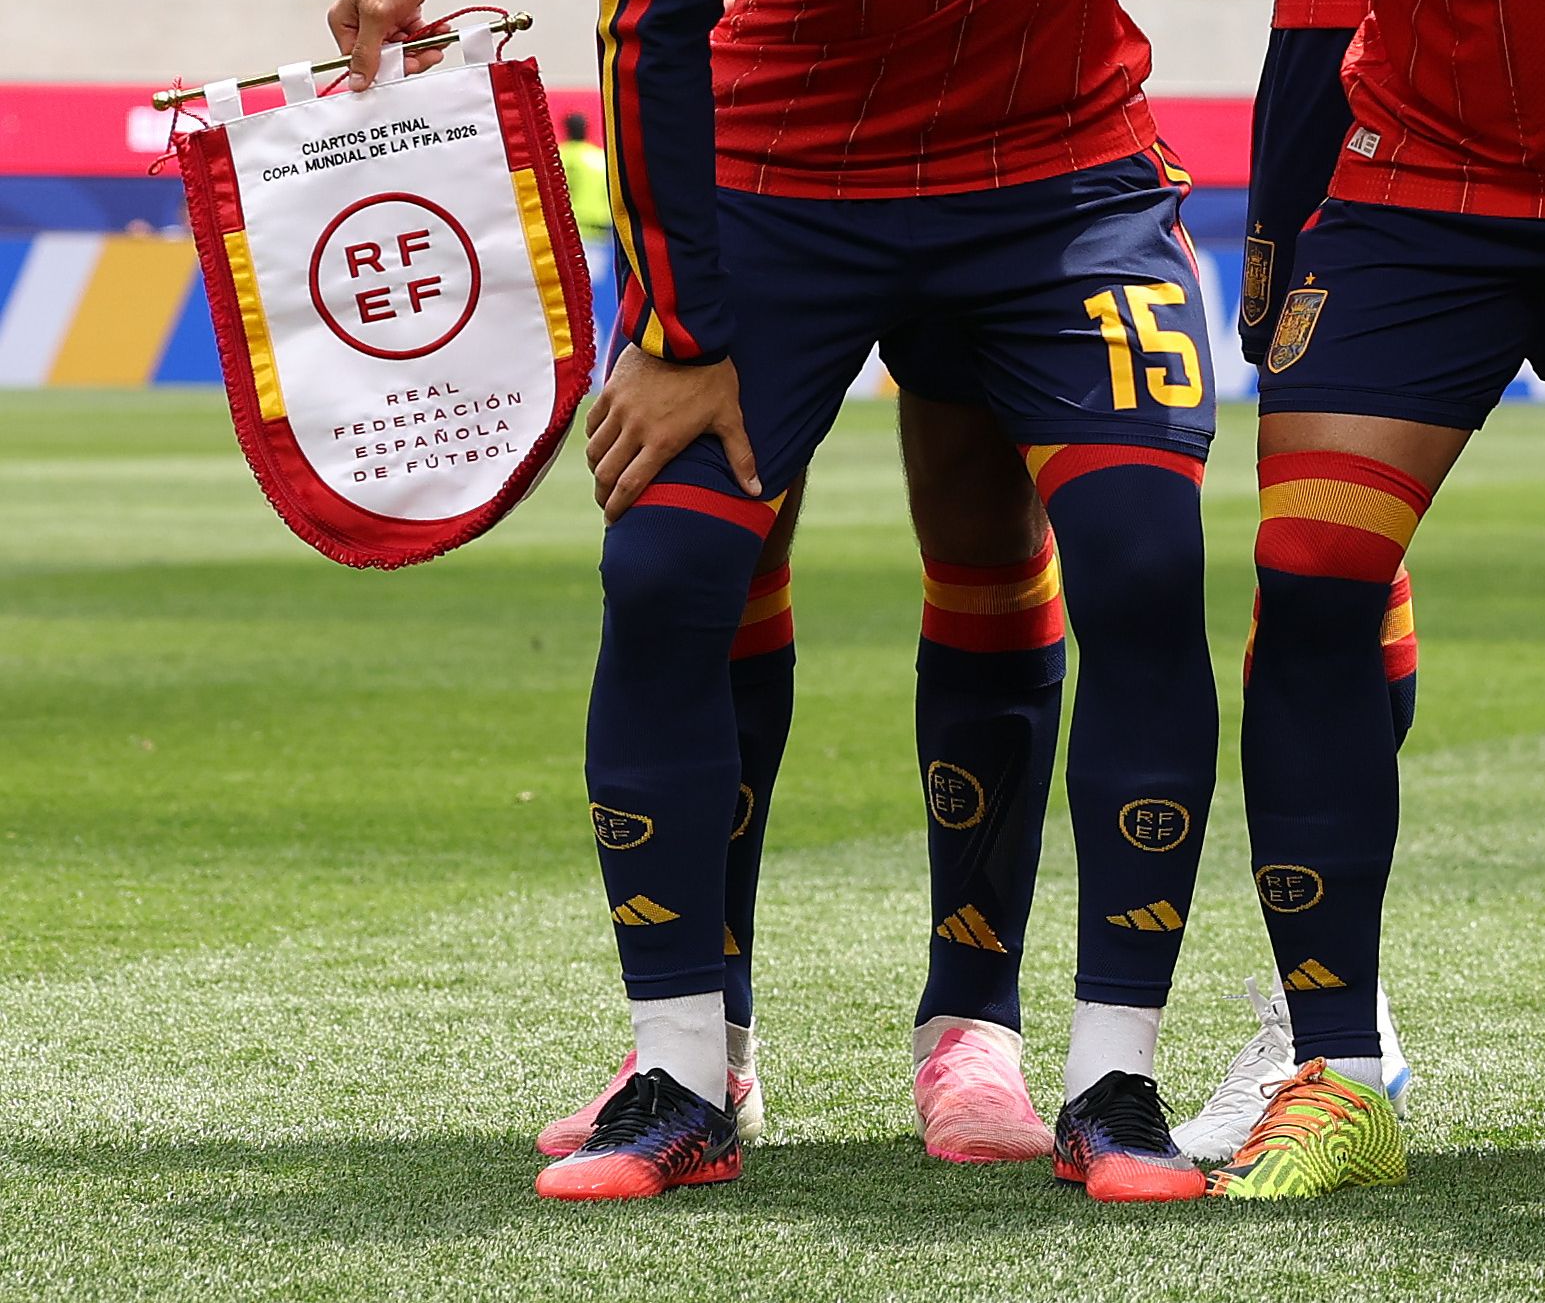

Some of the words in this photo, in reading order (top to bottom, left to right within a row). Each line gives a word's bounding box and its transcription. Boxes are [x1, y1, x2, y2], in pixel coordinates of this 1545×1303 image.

[263, 163, 299, 182] COPA
[305, 150, 366, 173] MUNDIAL
[370, 144, 387, 158] DE
[391, 139, 408, 153] LA
[412, 132, 442, 148] FIFA
[446, 124, 477, 142] 2026
[302, 131, 366, 155] CUARTOS
[370, 126, 388, 140] DE
[392, 117, 429, 136] FINAL
[1083, 282, 1205, 410] 15
[386, 382, 460, 406] REAL
[333, 392, 522, 440] FEDERACIÓN
[355, 419, 509, 459] ESPAÑOLA
[353, 467, 389, 483] DE
[407, 442, 518, 473] FÚTBOL
